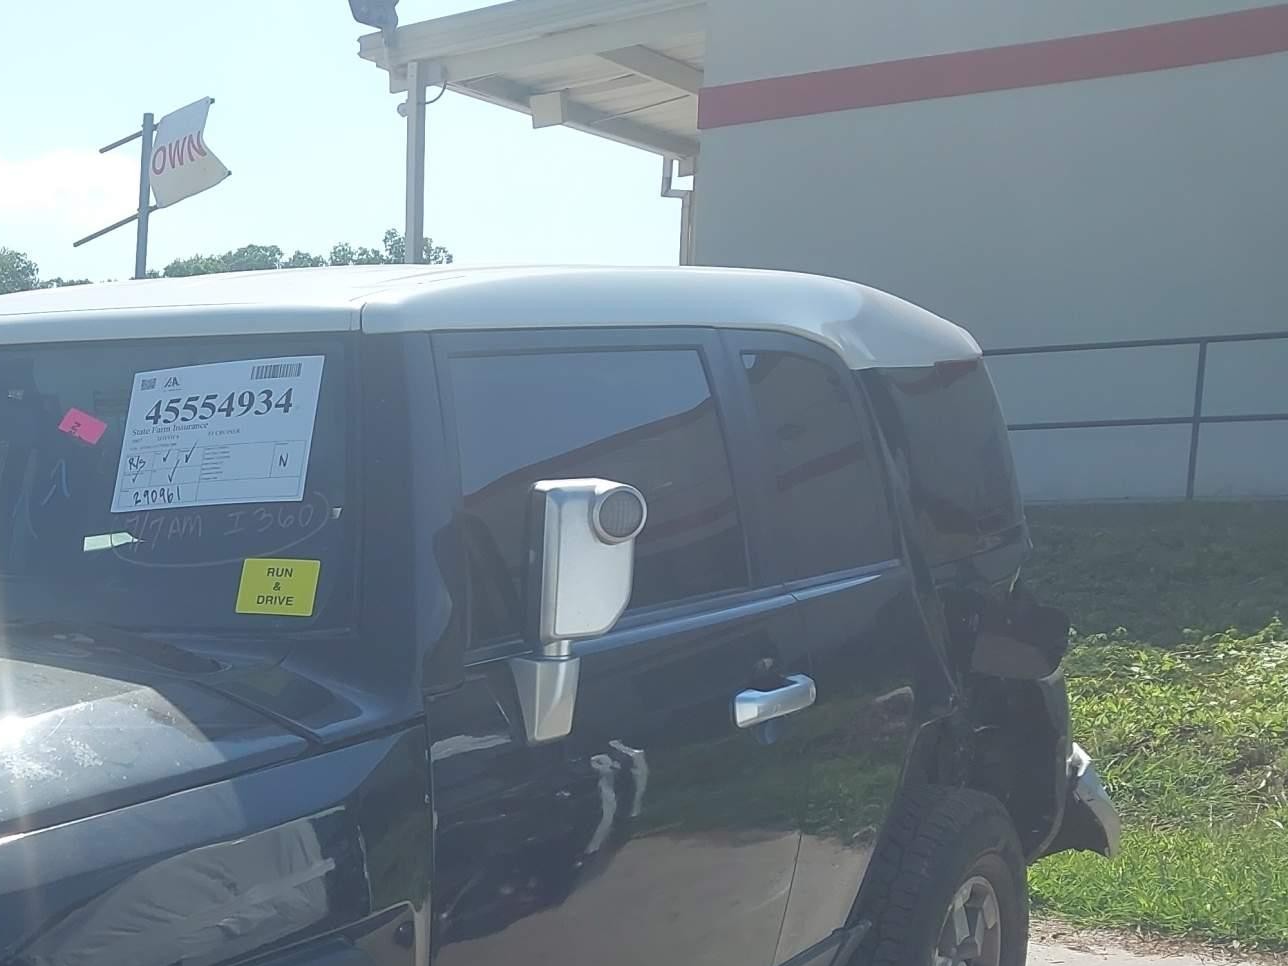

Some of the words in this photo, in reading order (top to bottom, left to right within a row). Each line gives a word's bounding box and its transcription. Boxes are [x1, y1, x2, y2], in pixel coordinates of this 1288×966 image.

[145, 387, 293, 425] 45554934
[132, 427, 149, 436] State
[151, 425, 171, 433] Farm
[172, 422, 209, 432] Insurance
[278, 453, 289, 467] N
[133, 486, 181, 504] 290961
[266, 567, 293, 578] RUN
[272, 581, 281, 591] &
[256, 595, 294, 606] DRIVE
